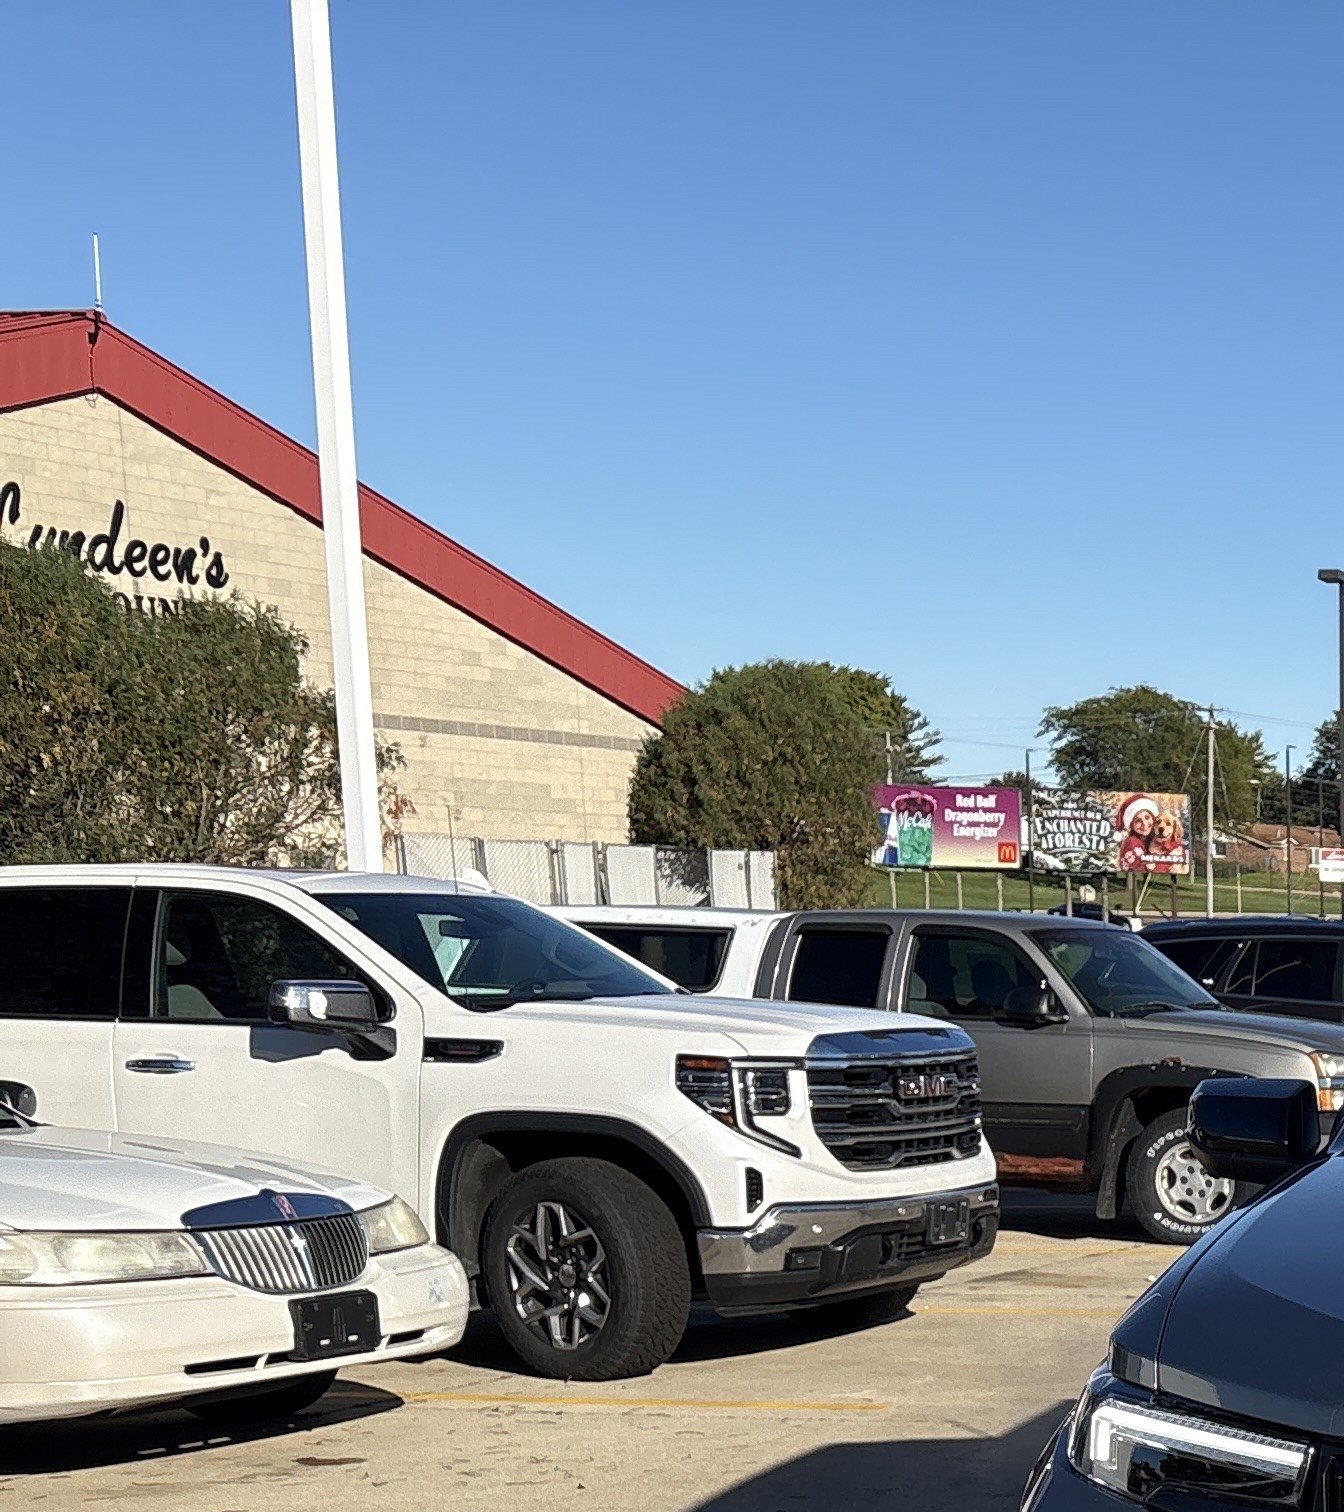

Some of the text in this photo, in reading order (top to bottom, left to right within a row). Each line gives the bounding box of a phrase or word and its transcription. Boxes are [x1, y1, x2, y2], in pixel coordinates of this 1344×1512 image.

[955, 793, 998, 808] Red Bull
[944, 808, 1006, 829] Dragonberry
[1034, 817, 1111, 837] ENCHANTED
[952, 823, 999, 841] Energizer
[1046, 832, 1101, 850] FOREST
